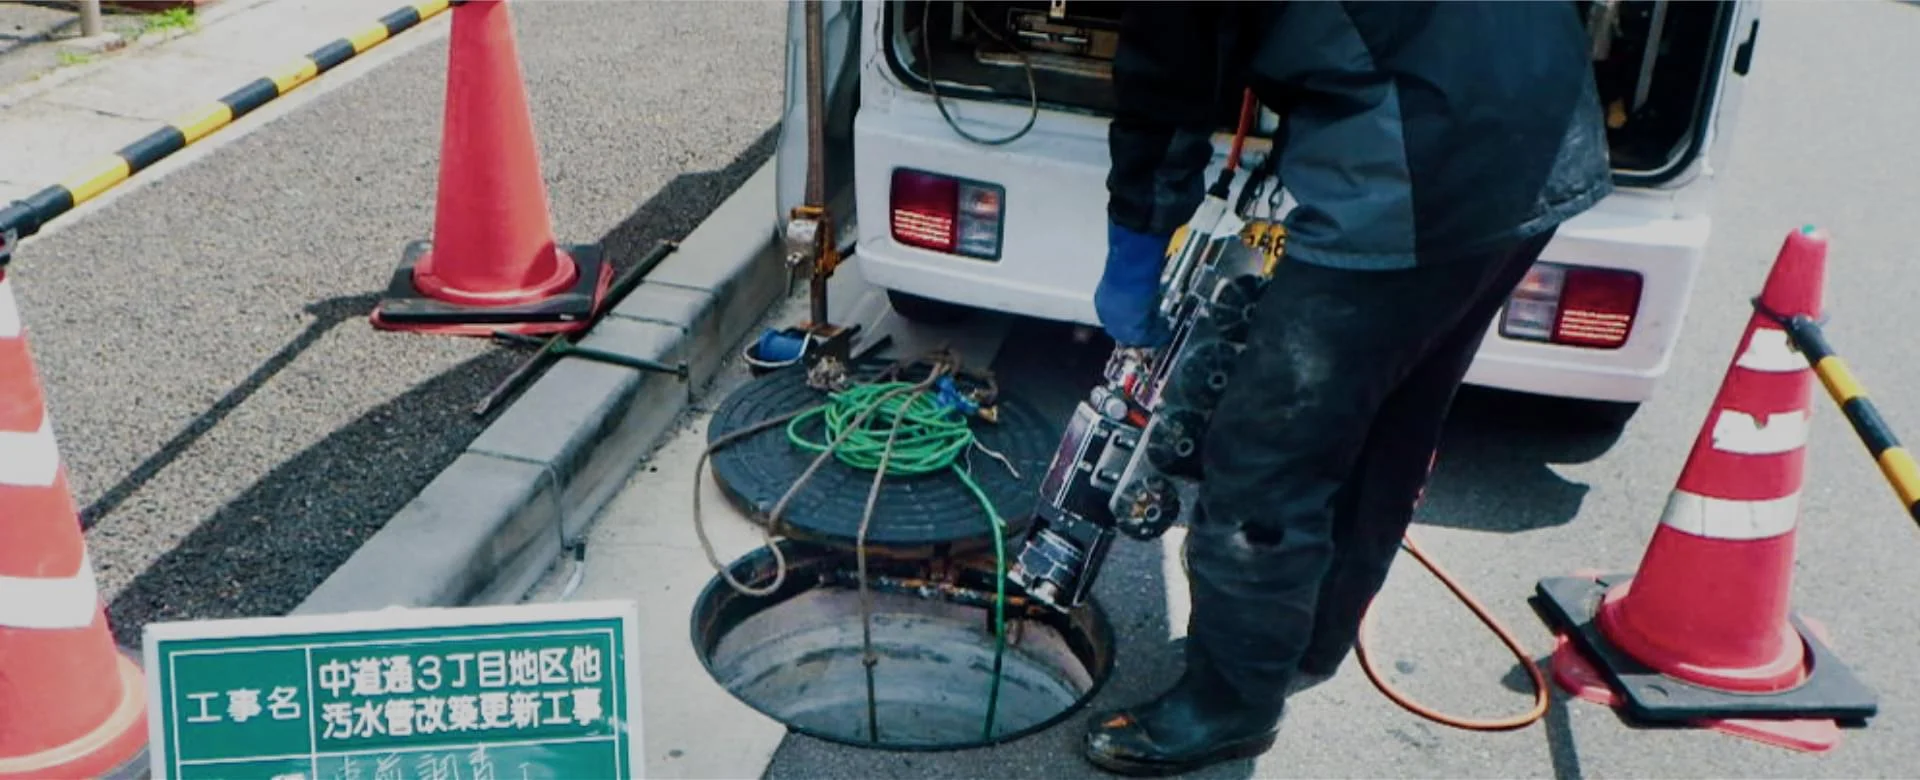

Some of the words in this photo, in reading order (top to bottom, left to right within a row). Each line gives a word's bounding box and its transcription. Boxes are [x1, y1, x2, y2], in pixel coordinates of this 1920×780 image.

[319, 644, 602, 698] 中道通3丁目地区他
[186, 686, 301, 723] 工事名
[321, 687, 603, 740] 汚水管改築更新工事
